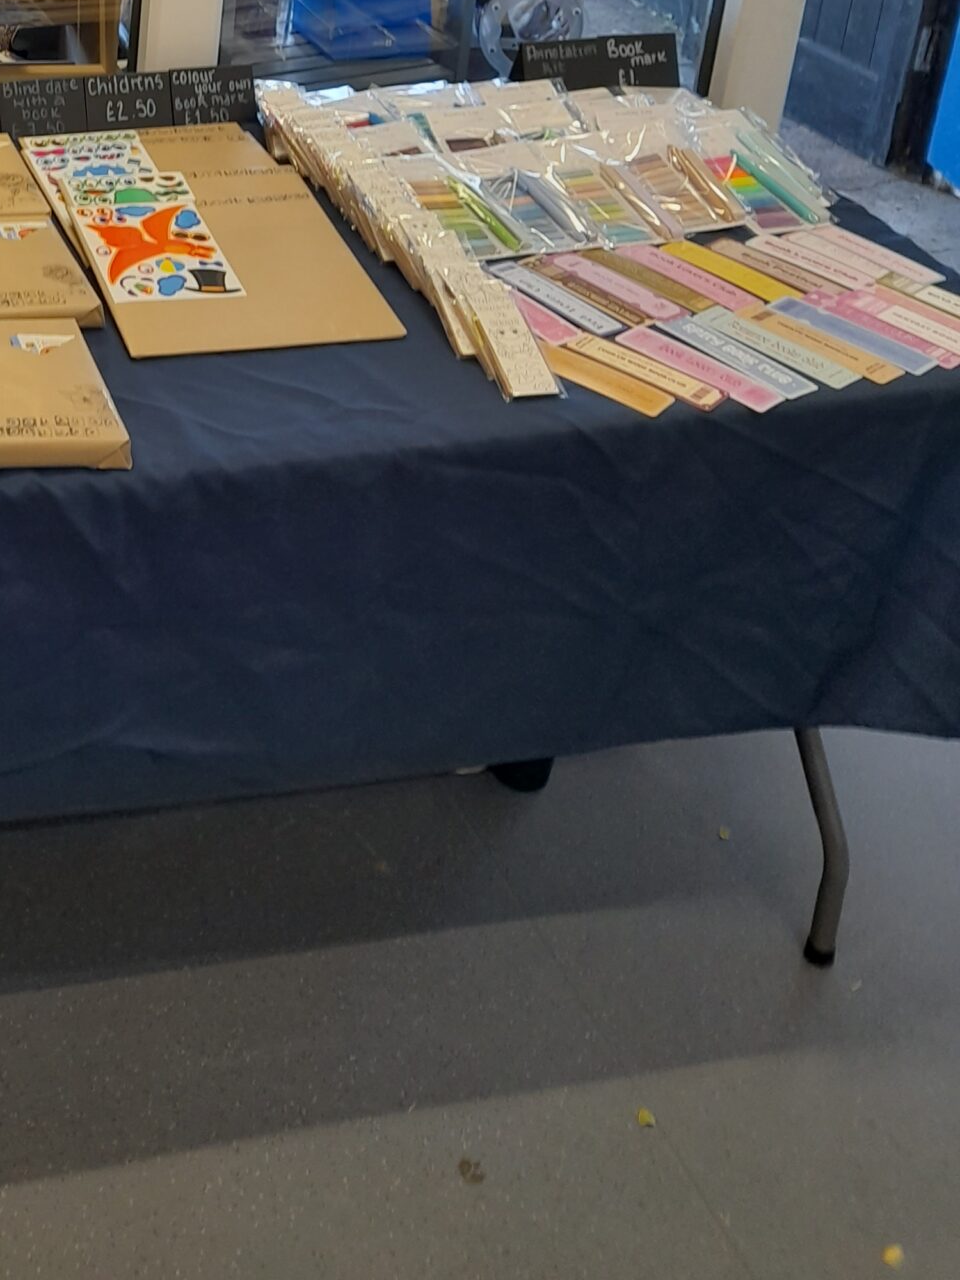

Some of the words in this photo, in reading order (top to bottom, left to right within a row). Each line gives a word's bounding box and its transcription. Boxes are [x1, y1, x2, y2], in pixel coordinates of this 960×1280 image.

[2, 81, 40, 99] Blind
[45, 79, 79, 95] date
[87, 73, 164, 97] Childrens
[194, 80, 222, 98] your
[229, 78, 251, 92] own
[22, 107, 62, 122] book
[106, 98, 157, 122] £2.50
